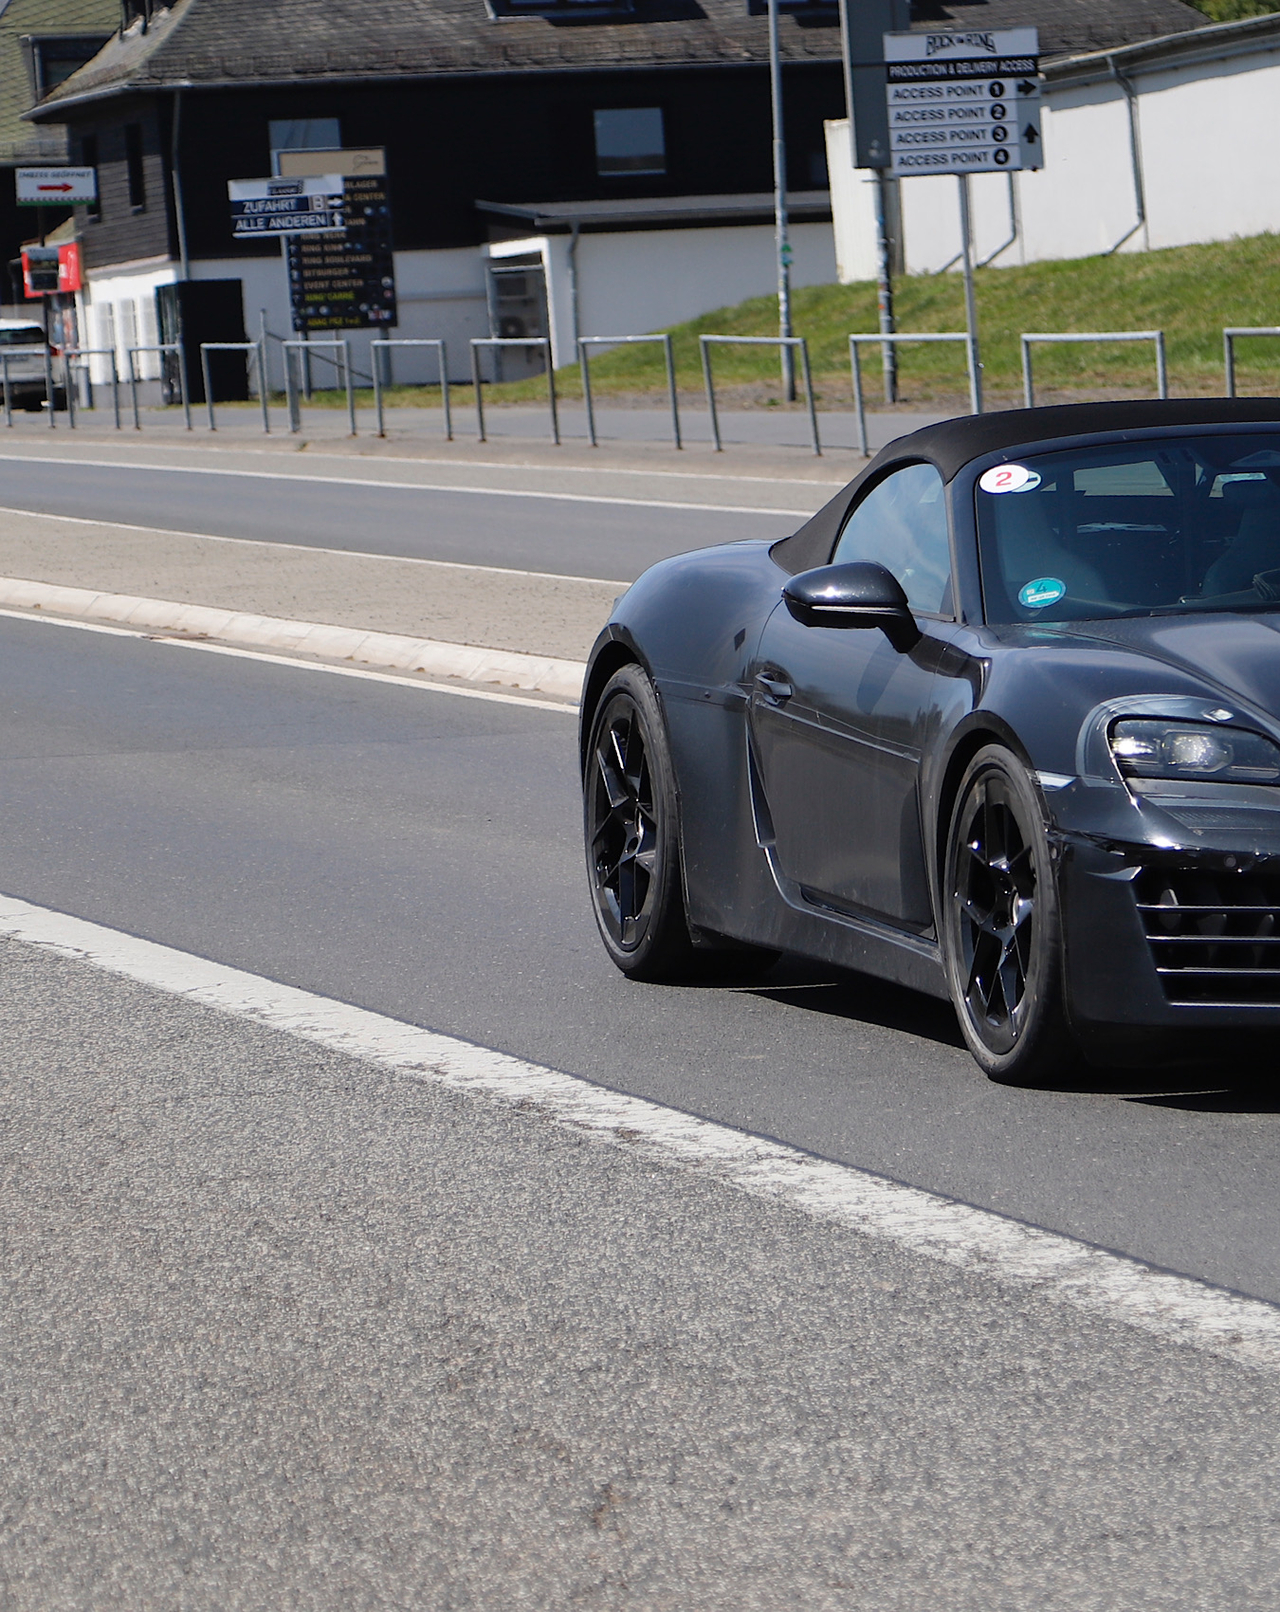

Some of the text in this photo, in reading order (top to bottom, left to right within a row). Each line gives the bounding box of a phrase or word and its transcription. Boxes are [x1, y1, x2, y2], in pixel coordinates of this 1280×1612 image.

[890, 59, 1035, 78] PRODUCTION & DELIVERY ACCESS
[893, 86, 943, 99] ACCESS
[947, 84, 984, 97] POINT
[895, 109, 945, 122] ACCESS
[948, 107, 985, 119] POINT
[896, 131, 946, 144] ACCESS
[950, 129, 987, 141] POINT
[898, 154, 948, 167] ACCESS
[951, 151, 988, 164] POINT
[243, 195, 324, 214] ZUFAHRT B
[235, 214, 327, 231] ALLE ANDEREN
[995, 471, 1012, 487] 2
[1036, 582, 1048, 592] 4
